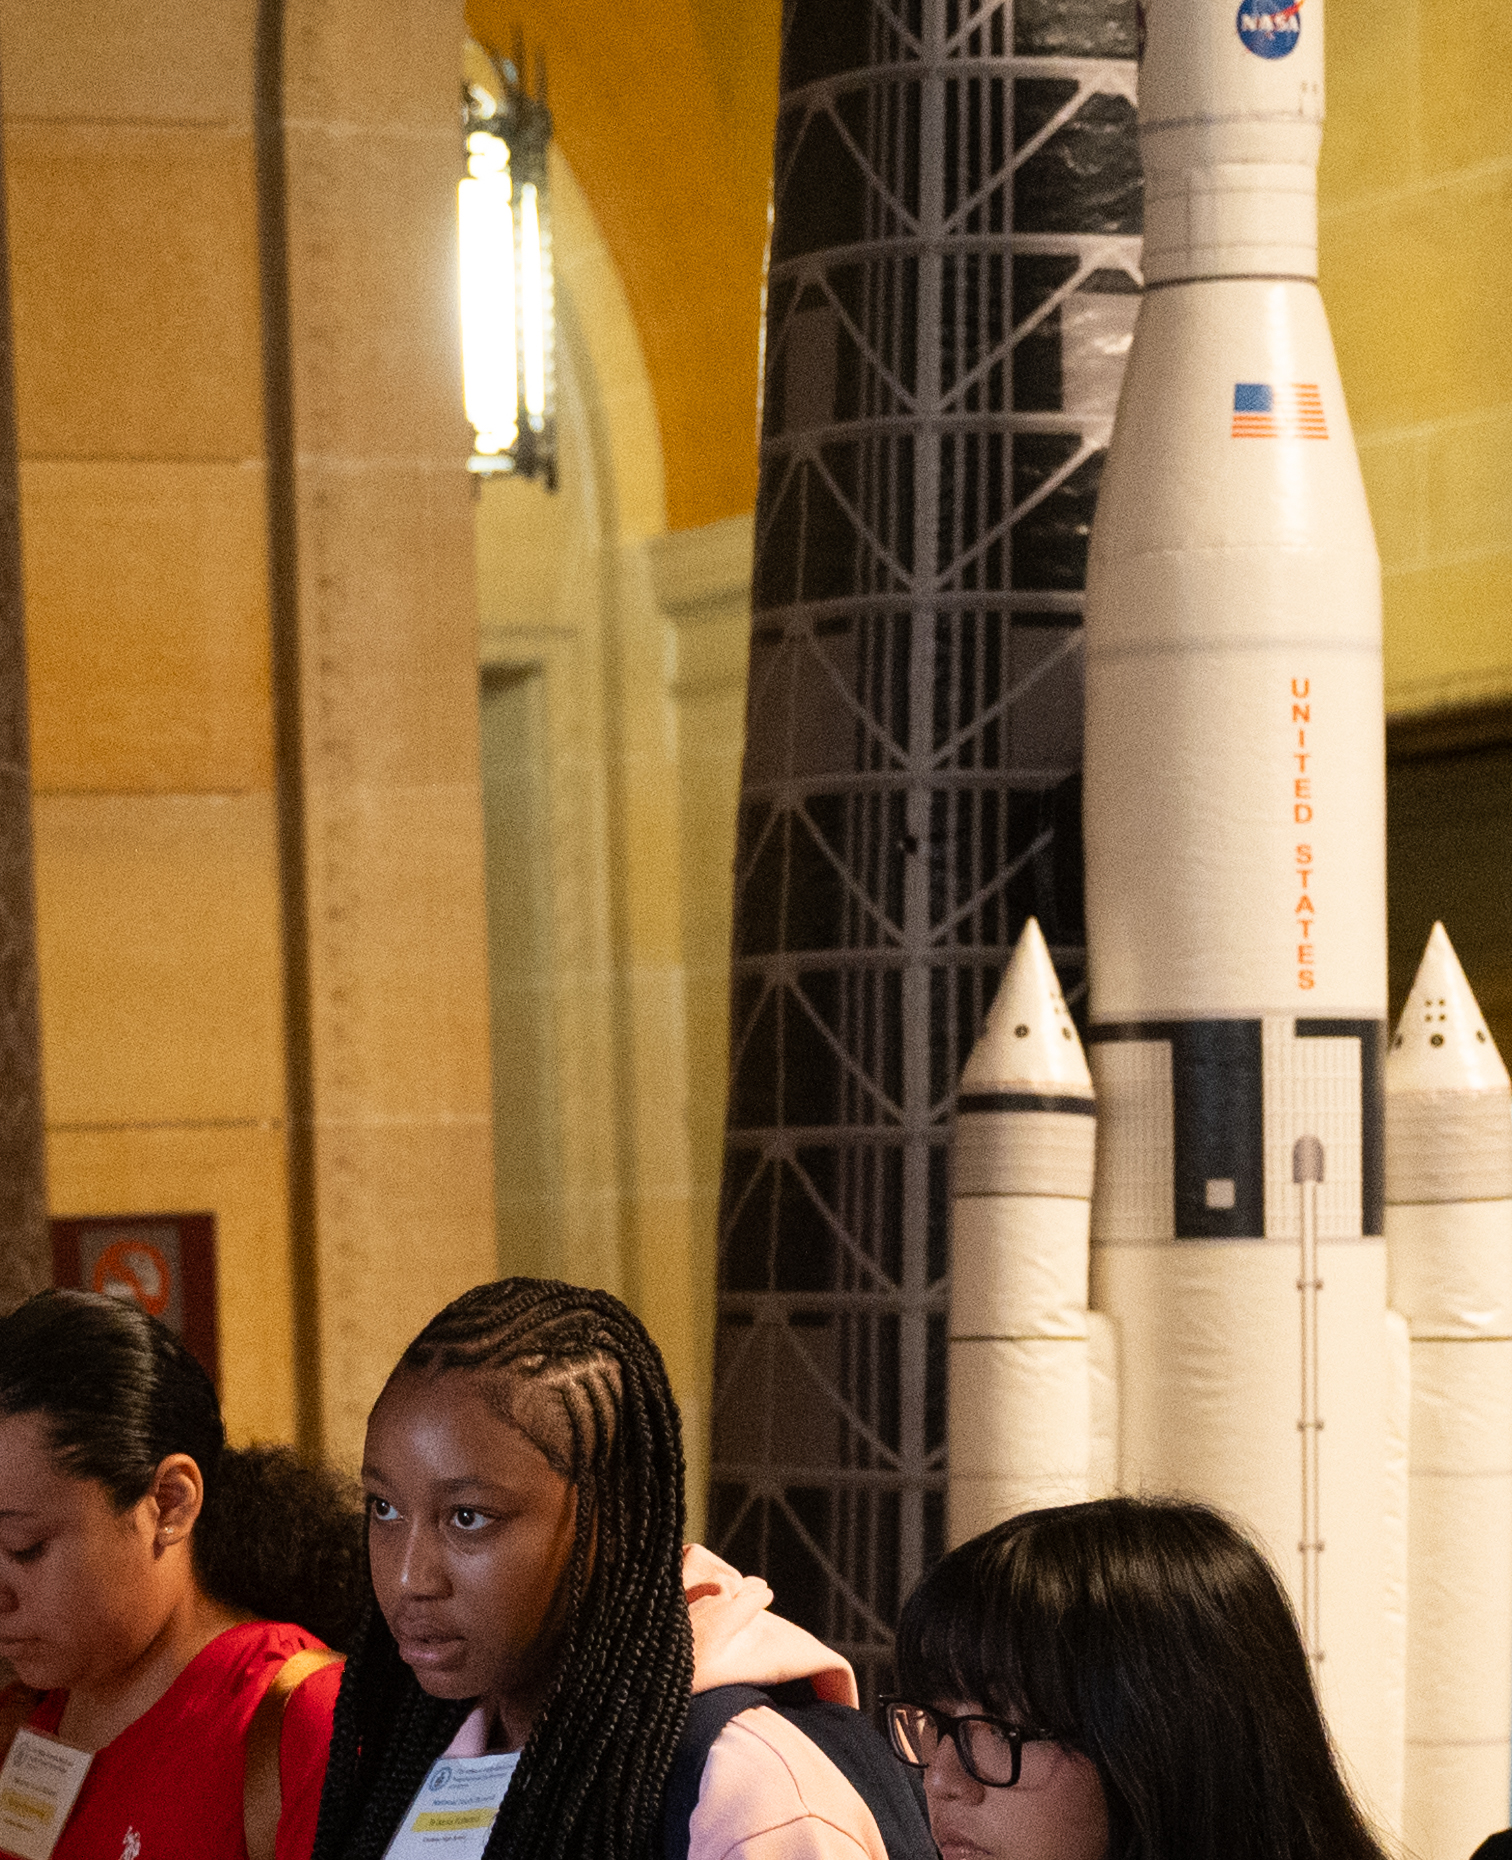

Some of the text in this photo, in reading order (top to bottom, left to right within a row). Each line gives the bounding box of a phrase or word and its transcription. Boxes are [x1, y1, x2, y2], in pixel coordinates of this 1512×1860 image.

[1240, 12, 1301, 34] NASA
[1291, 677, 1316, 990] UNITED STATES
